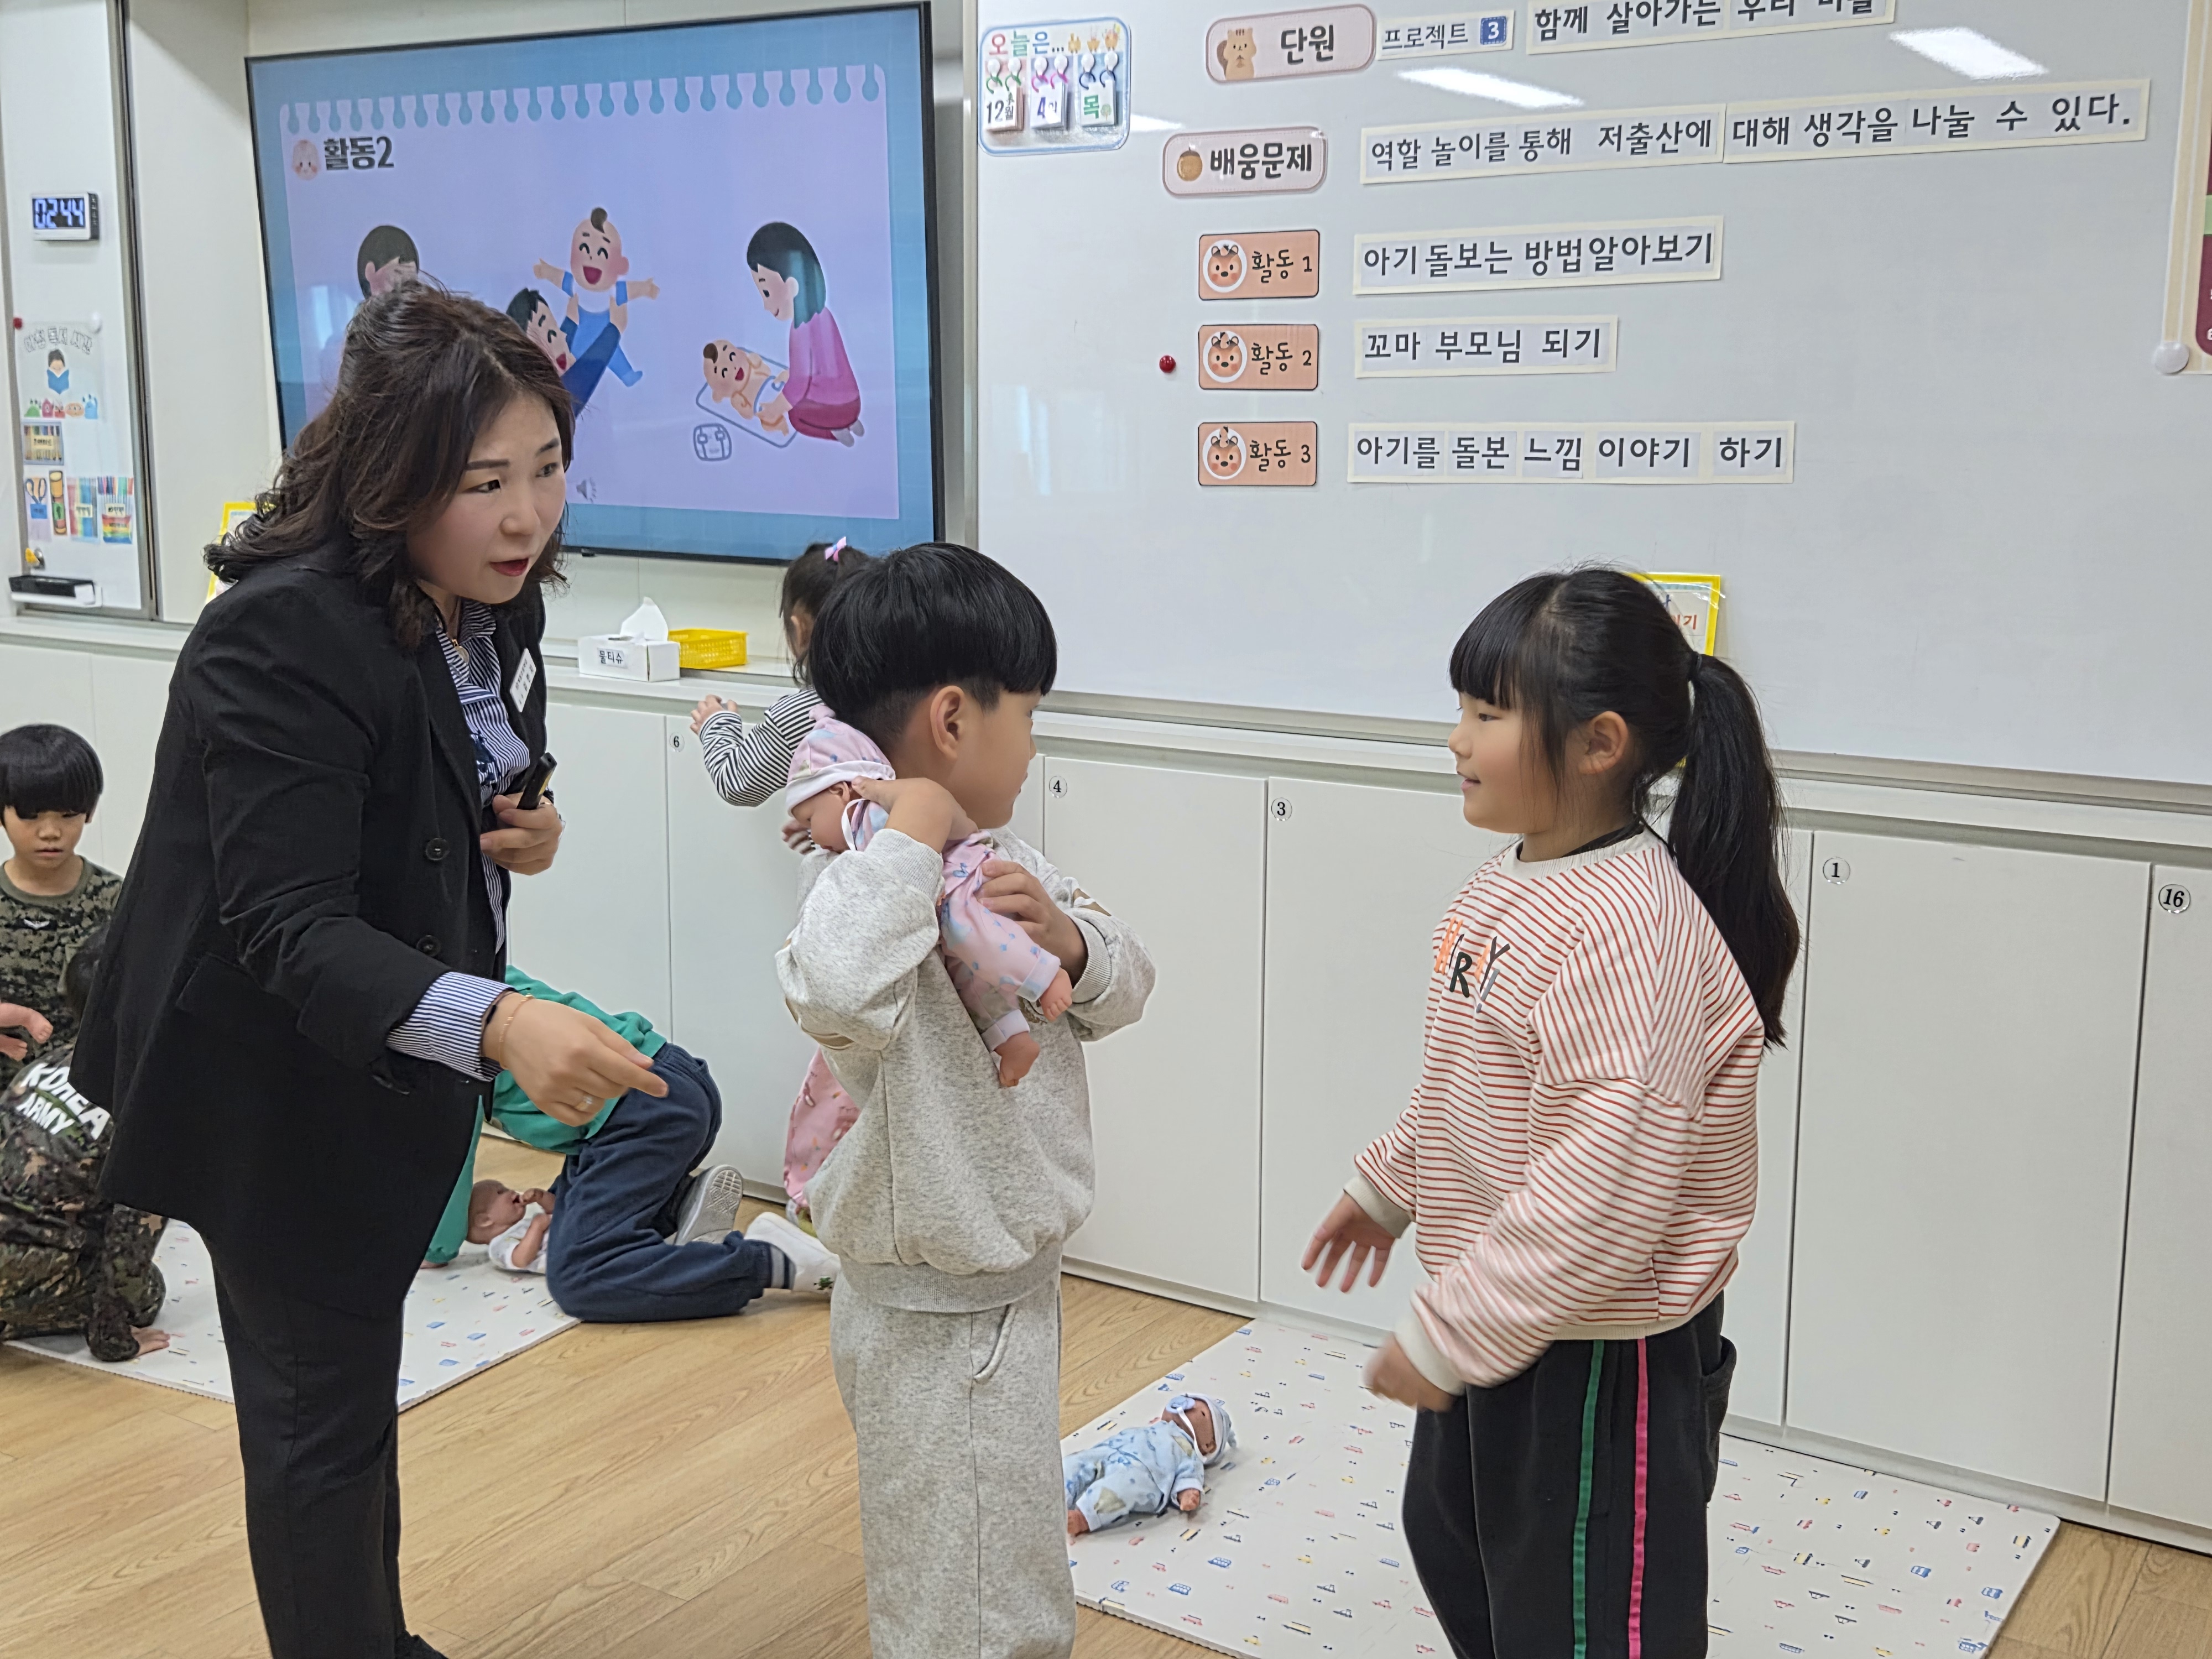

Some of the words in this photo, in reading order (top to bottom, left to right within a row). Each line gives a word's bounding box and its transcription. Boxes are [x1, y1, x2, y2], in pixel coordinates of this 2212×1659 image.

[1383, 23, 1468, 50] 프로젝트
[1488, 22, 1499, 39] 3
[1535, 6, 1588, 41] 함께
[1606, 0, 1721, 35] 살아가는
[1281, 24, 1334, 65] 단원
[1083, 94, 1100, 119] 목
[1372, 139, 1421, 171] 역할
[1431, 132, 1510, 166] 놀이를
[1519, 128, 1571, 162] 통해
[1598, 119, 1711, 155] 저출산에
[1733, 116, 1790, 147] 대해
[1804, 107, 1898, 147] 생각을
[1913, 105, 1975, 138] 나눌
[1996, 101, 2028, 131] 수
[2052, 93, 2130, 132] 있다.
[324, 136, 394, 170] 활동2
[1210, 143, 1312, 180] 배움문제
[1251, 249, 1293, 283] 활동
[1302, 256, 1312, 272] 1
[1364, 246, 1416, 276] 아기
[1425, 242, 1512, 278] 돌보는
[1251, 342, 1293, 375] 활동
[1302, 350, 1312, 366] 2
[1365, 332, 1421, 360] 꼬마
[1436, 330, 1521, 363] 부모님
[1542, 328, 1600, 358] 되기
[1249, 439, 1291, 472] 활동
[1301, 444, 1311, 463] 3
[1357, 437, 1440, 469] 아기를
[1452, 437, 1509, 469] 돌본
[1524, 438, 1581, 471] 느낌
[1599, 438, 1689, 468] 이야기
[1719, 437, 1781, 468] 하기
[599, 650, 623, 664] 물티슈
[674, 736, 680, 748] 6
[1053, 780, 1062, 793] 4
[1276, 801, 1286, 817] 3
[1831, 862, 1840, 878] 1
[2163, 888, 2184, 908] 16
[16, 1093, 75, 1135] ARMY
[20, 1063, 110, 1140] KOREA
